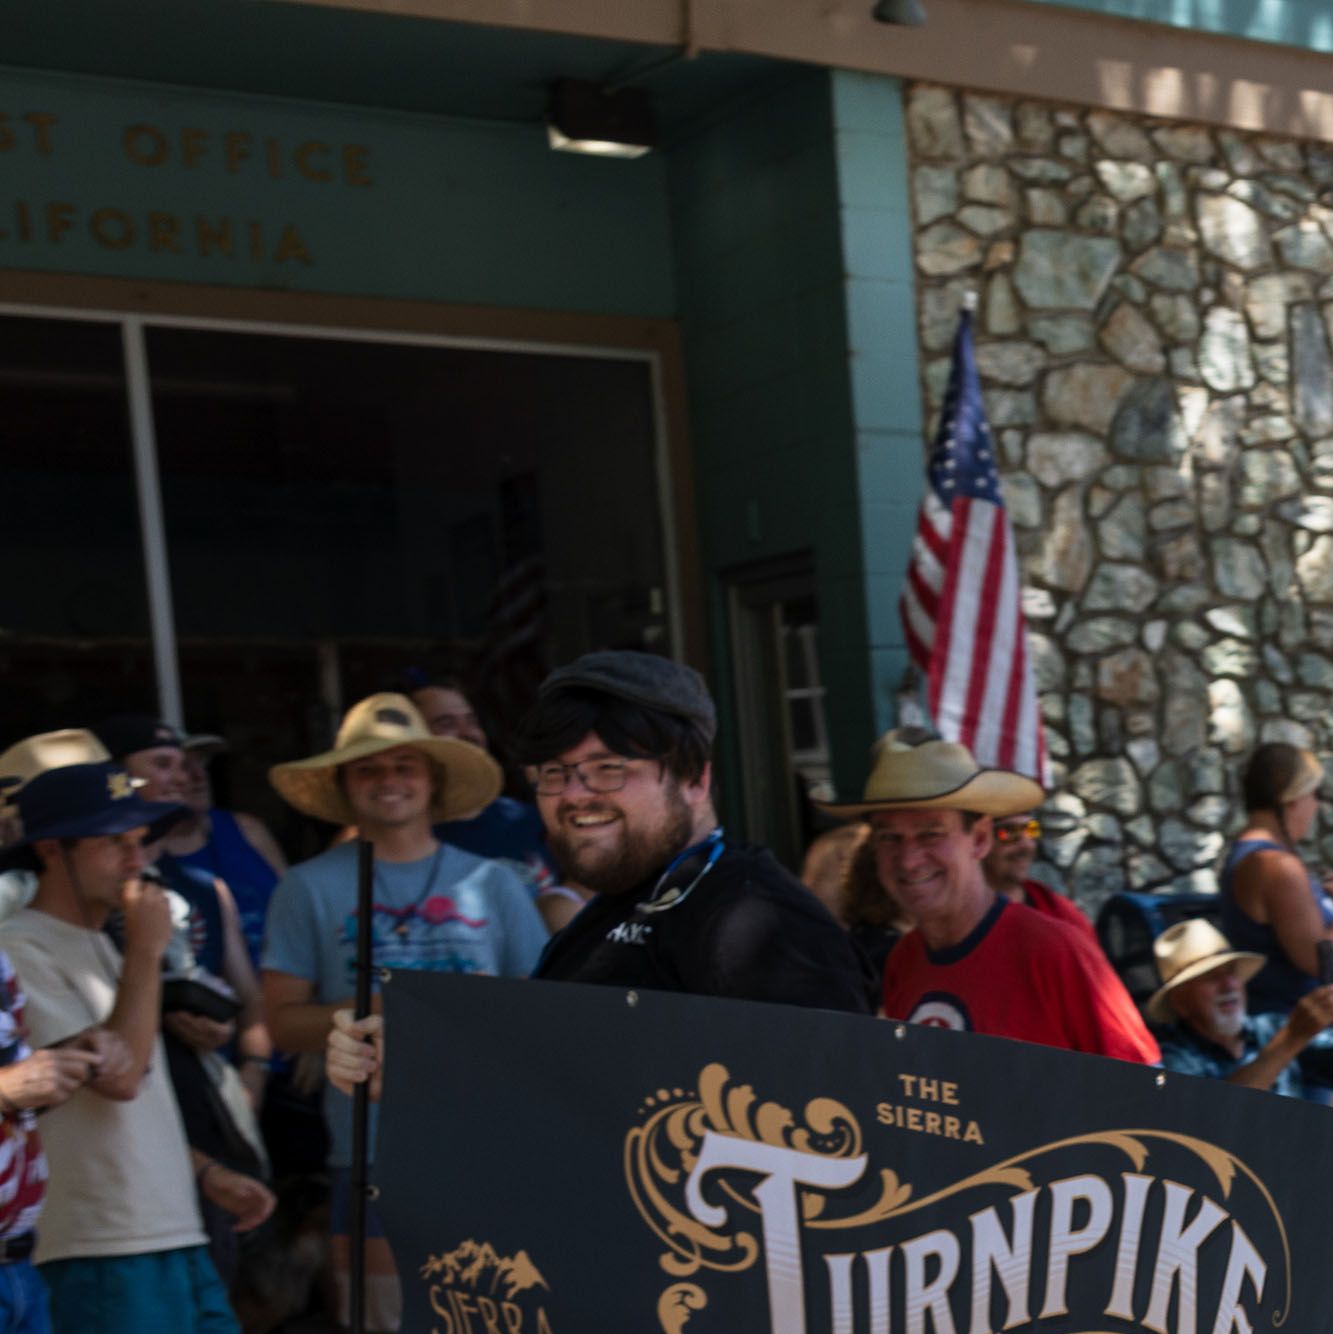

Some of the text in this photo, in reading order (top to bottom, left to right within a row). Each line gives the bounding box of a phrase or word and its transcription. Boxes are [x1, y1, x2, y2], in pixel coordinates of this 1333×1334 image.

[121, 122, 374, 188] OFFICE
[0, 200, 316, 268] IFORNIA
[898, 1073, 961, 1105] THE
[876, 1102, 985, 1145] SIERRA
